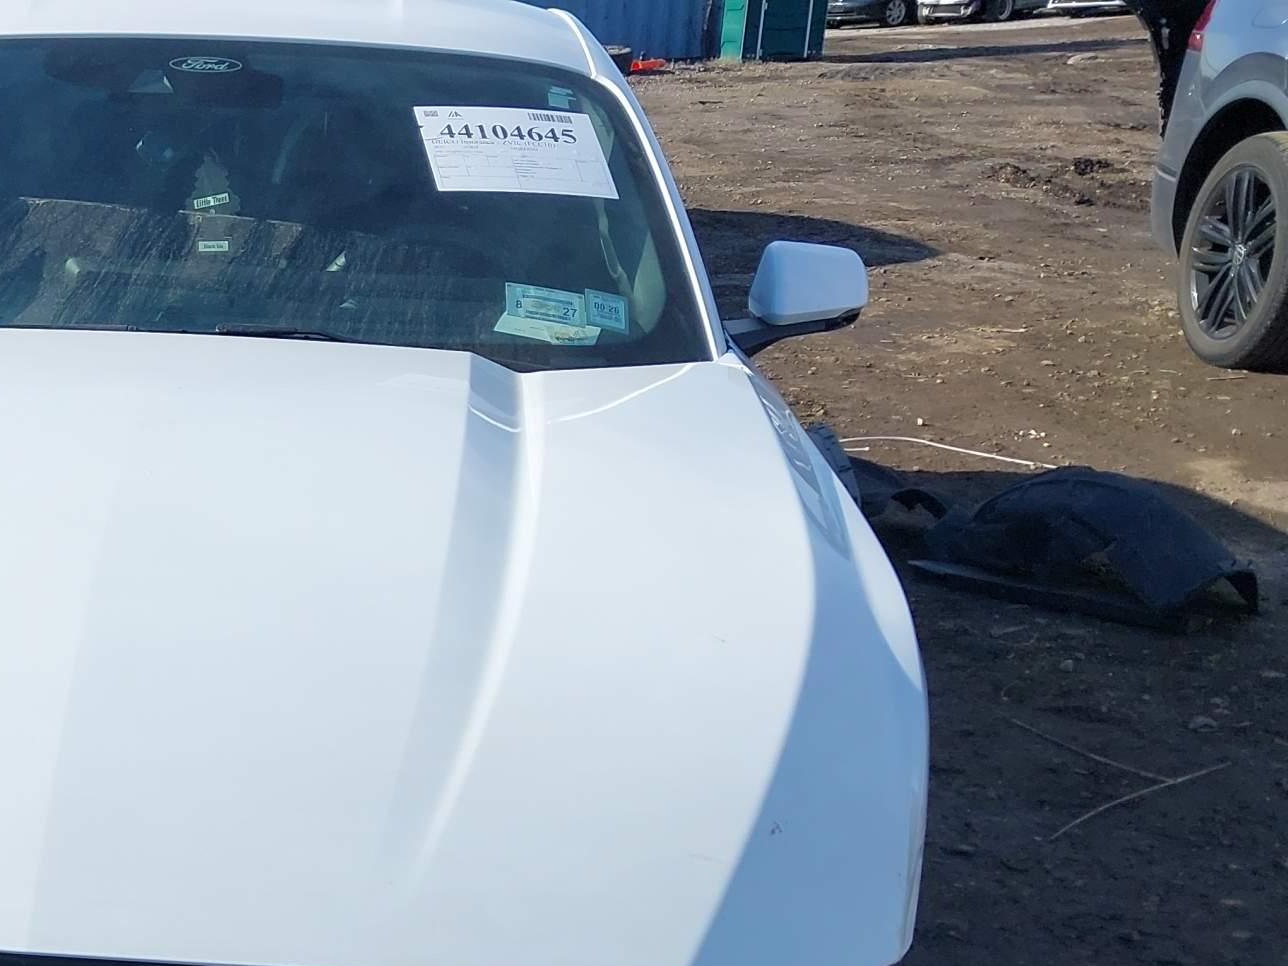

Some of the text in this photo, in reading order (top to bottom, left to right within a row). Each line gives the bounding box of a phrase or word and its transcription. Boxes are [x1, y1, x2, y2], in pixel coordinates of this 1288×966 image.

[182, 58, 228, 70] Ford
[440, 123, 577, 145] 44104645
[562, 307, 578, 318] 27
